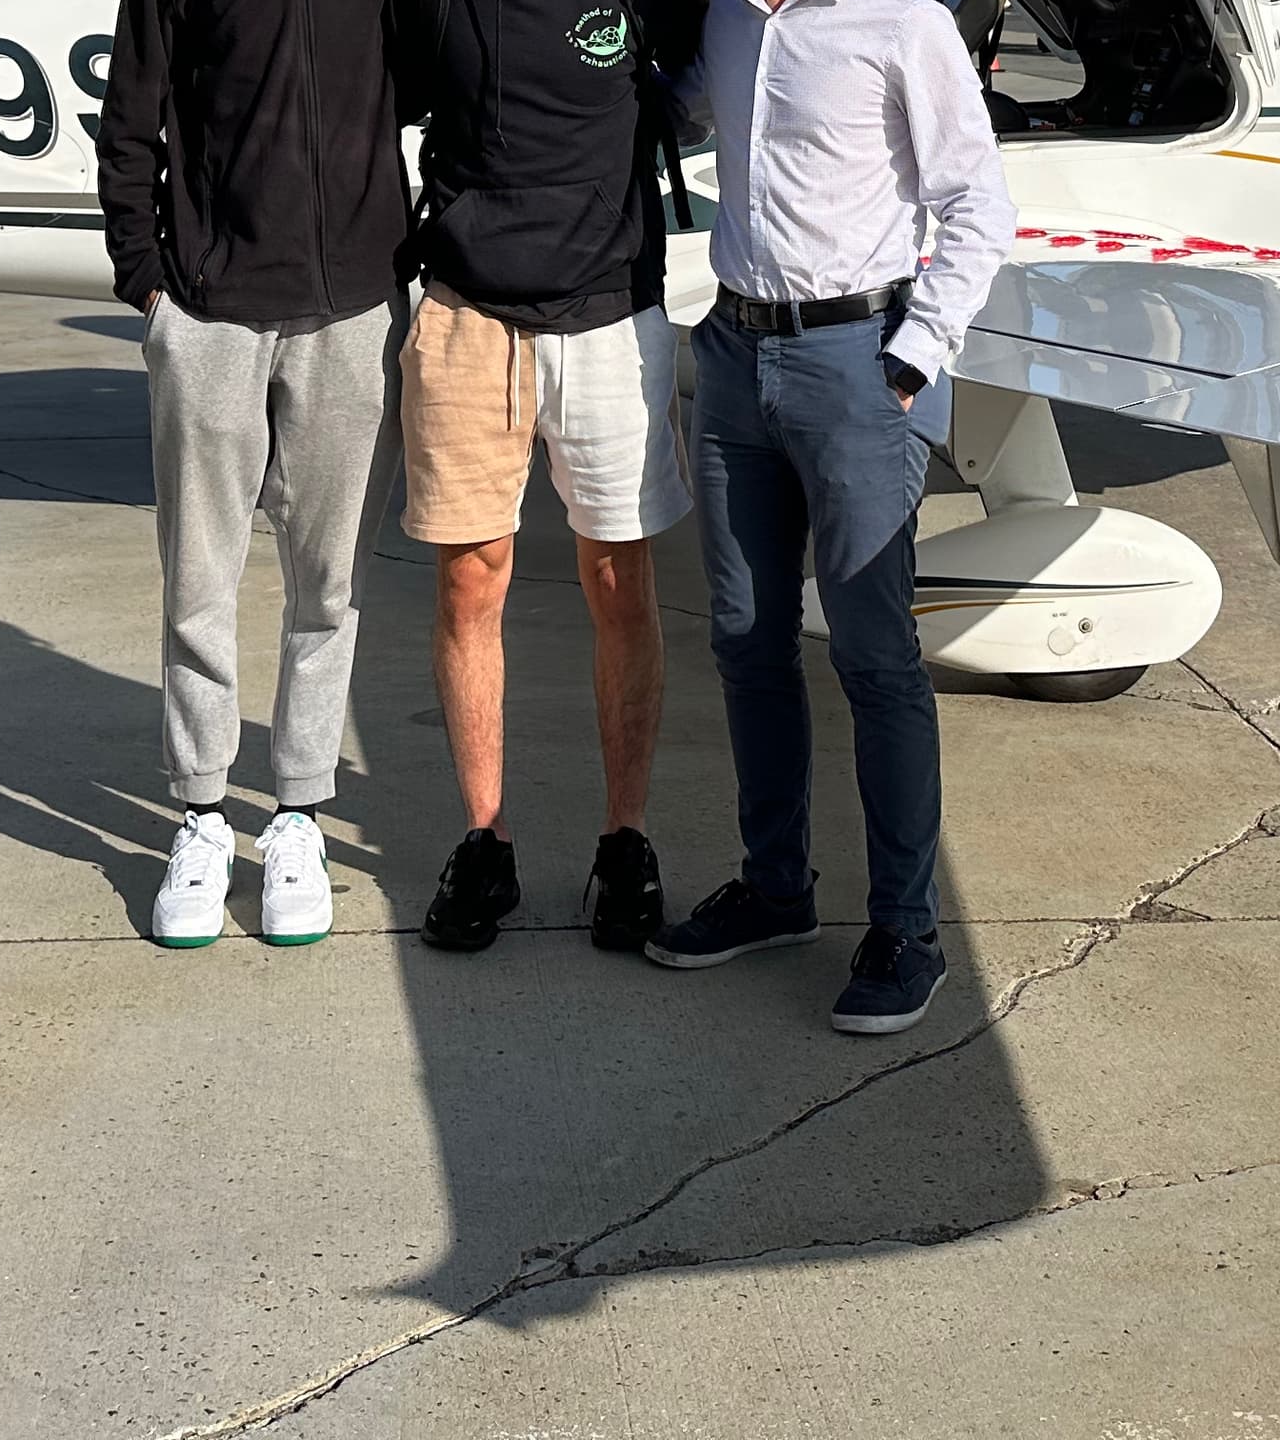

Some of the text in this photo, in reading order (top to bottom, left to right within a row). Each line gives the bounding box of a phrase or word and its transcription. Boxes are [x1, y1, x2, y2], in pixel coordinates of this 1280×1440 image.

[575, 7, 613, 32] method of
[580, 49, 628, 68] exhaustion
